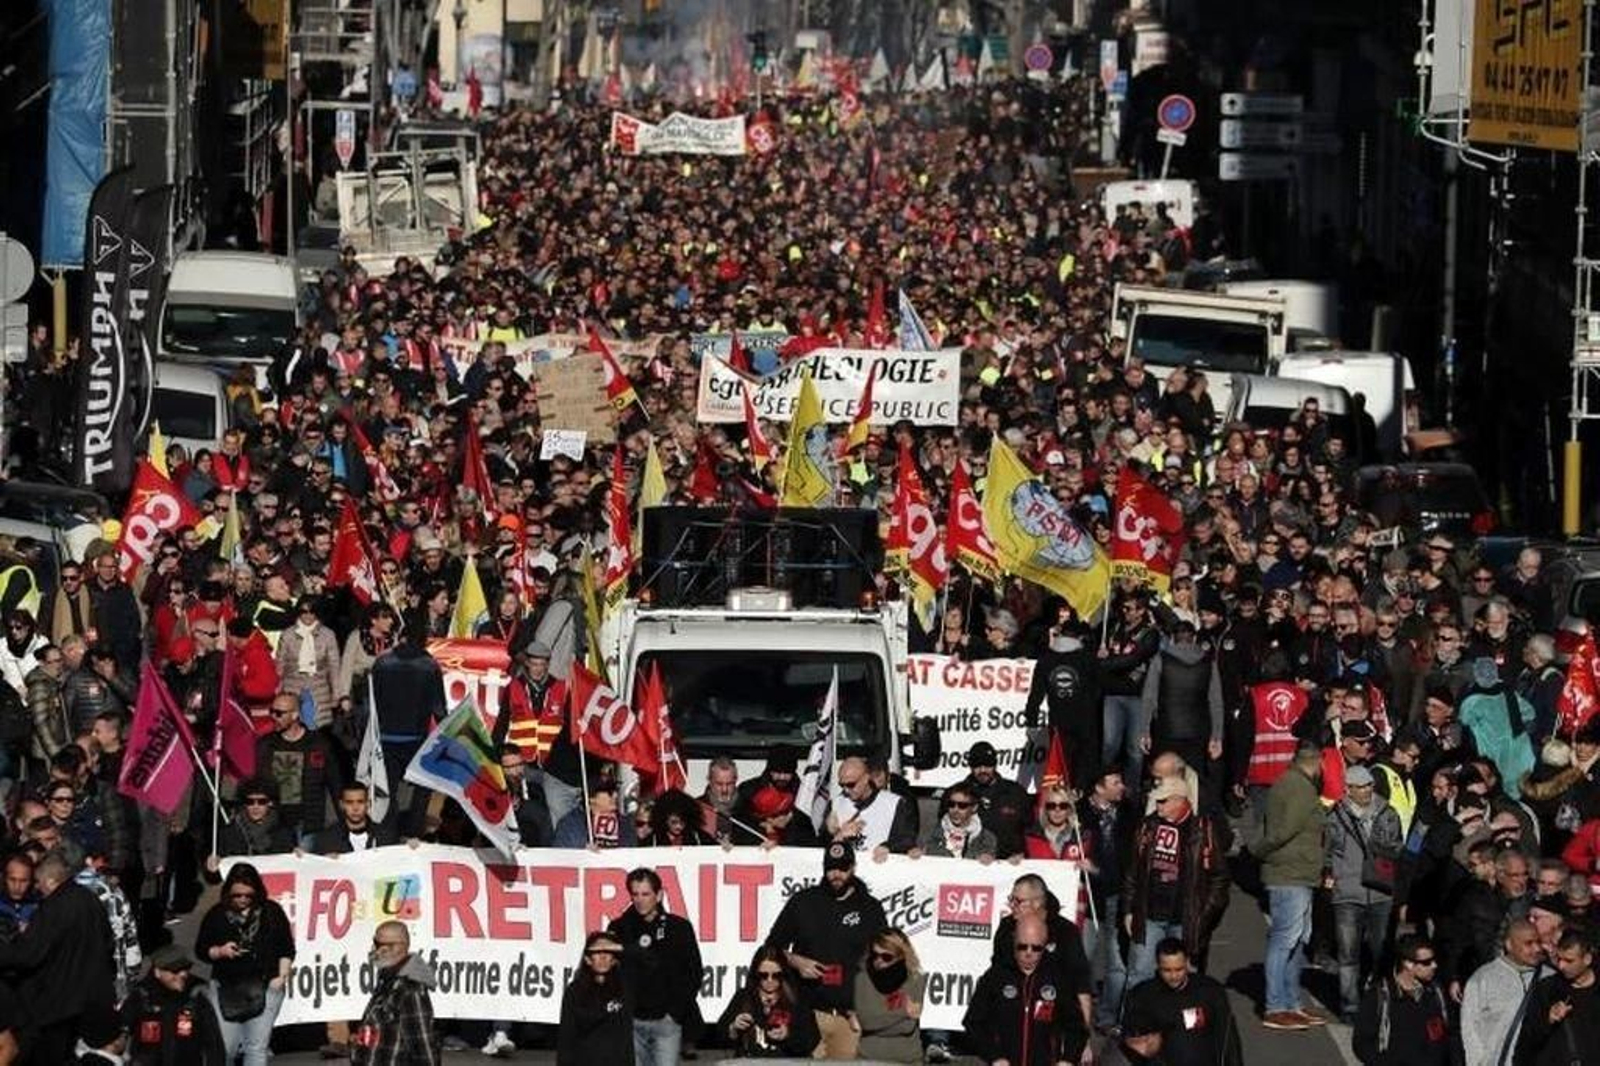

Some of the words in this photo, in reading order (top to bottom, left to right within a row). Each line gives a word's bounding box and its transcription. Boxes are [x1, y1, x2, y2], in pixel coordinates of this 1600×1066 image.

[84, 271, 115, 485] TRIUMPH
[765, 398, 857, 417] SERICE
[871, 400, 950, 419] PUBLIC
[906, 659, 935, 686] AT
[578, 684, 636, 745] FO
[595, 815, 616, 836] FO
[1157, 828, 1176, 848] FO
[307, 879, 357, 941] FO
[431, 861, 774, 943] RETRAIT
[945, 889, 988, 916] SAF
[288, 954, 351, 1008] rojet
[423, 949, 501, 996] forme
[509, 951, 553, 997] des
